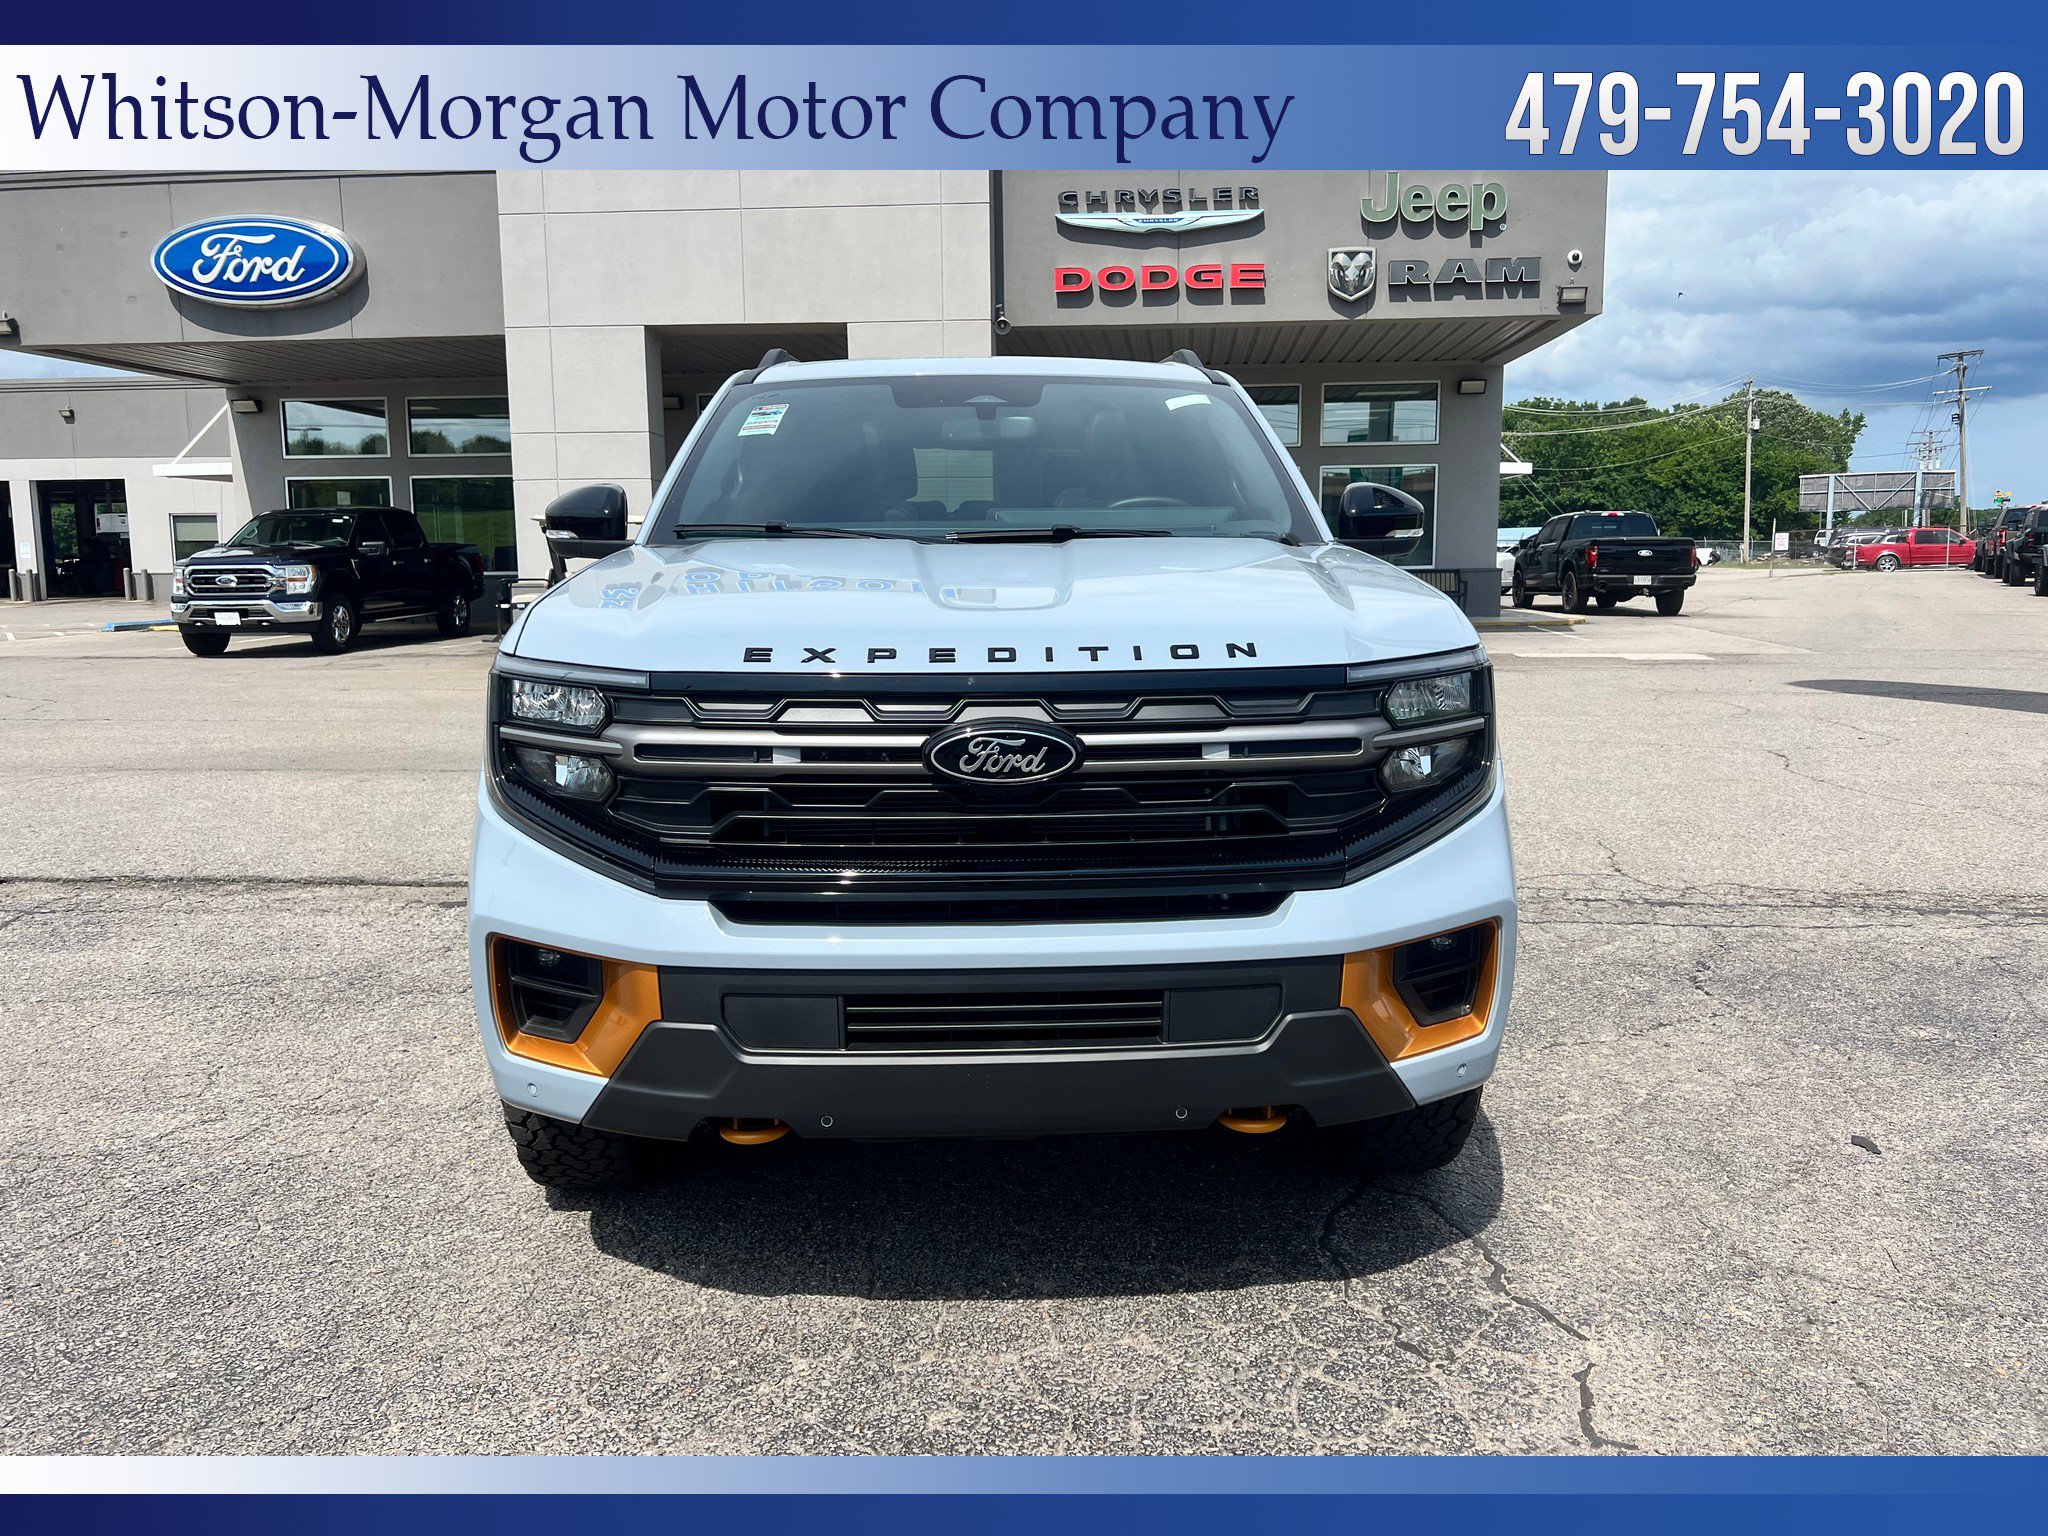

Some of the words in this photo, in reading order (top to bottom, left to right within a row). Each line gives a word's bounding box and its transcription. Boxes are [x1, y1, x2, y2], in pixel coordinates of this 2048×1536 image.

[1057, 186, 1260, 205] CHRYSLER
[1360, 172, 1508, 231] Jeep
[192, 233, 306, 284] Ford
[1388, 257, 1542, 284] RAM
[1054, 264, 1266, 292] DODGE
[743, 642, 1258, 664] EXPEDITION
[958, 737, 1049, 773] Ford
